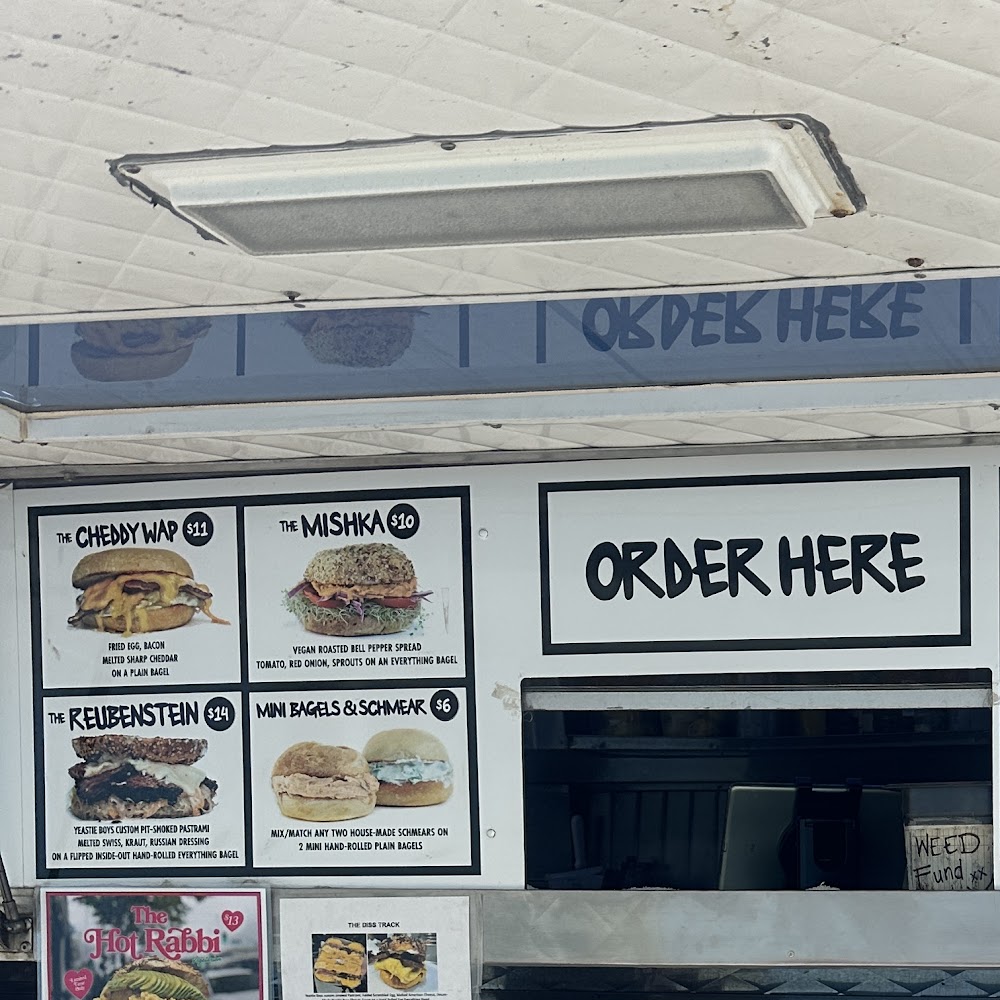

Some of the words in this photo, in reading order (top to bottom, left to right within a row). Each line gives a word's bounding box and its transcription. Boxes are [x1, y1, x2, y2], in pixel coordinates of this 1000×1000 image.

[56, 532, 72, 543] THE
[75, 521, 139, 548] CHEDDY
[141, 518, 178, 544] WAP
[186, 523, 209, 538] $11
[278, 520, 298, 532] THE
[300, 509, 385, 538] MISHKA
[391, 514, 415, 530] $10
[585, 537, 771, 600] ORDER
[778, 531, 925, 596] HERE
[108, 642, 125, 651] FRIED
[127, 641, 141, 651] EGG,
[143, 640, 164, 649] BACON
[292, 645, 315, 654] VEGAN
[318, 644, 348, 653] ROASTED
[350, 644, 365, 652] BELL
[367, 643, 392, 652] PEPPER
[395, 642, 421, 651] SPREAD
[47, 712, 65, 724] THE
[68, 700, 198, 731] REUBENSTEIN
[207, 706, 229, 722] $14
[255, 701, 286, 718] MINI
[289, 700, 340, 718] BAGELS
[342, 699, 358, 716] &
[358, 698, 427, 716] SCHMEAR
[436, 699, 451, 713] $6
[915, 833, 980, 856] WEED
[913, 859, 963, 890] Fund
[130, 905, 168, 925] The
[224, 913, 239, 926] $13
[84, 928, 143, 960] Hot
[145, 927, 221, 960] Rabbi
